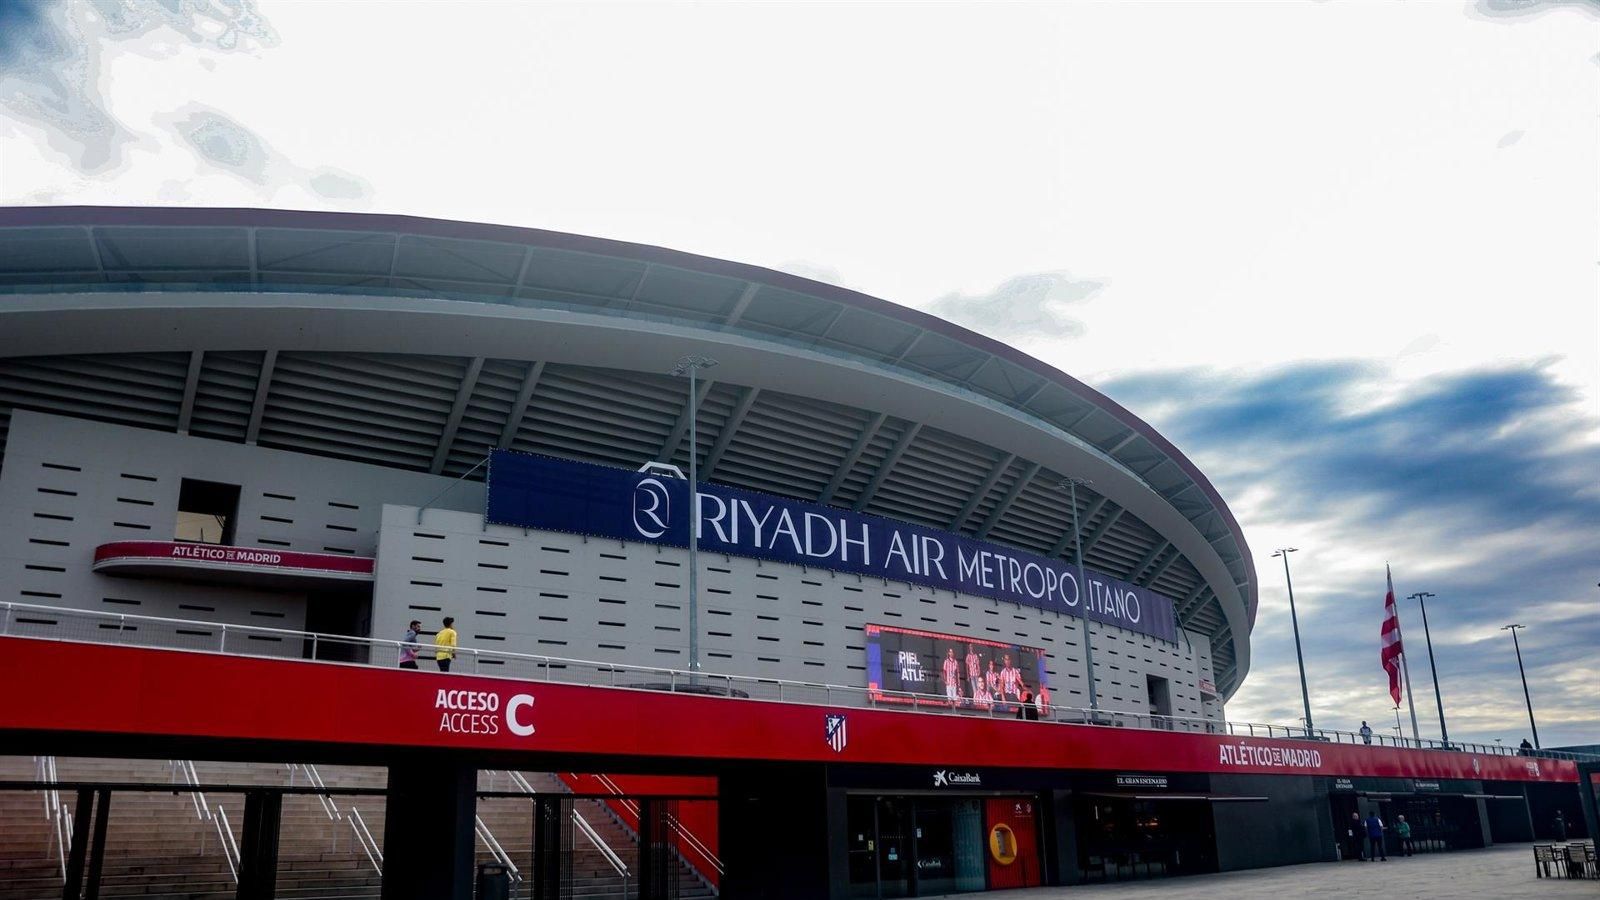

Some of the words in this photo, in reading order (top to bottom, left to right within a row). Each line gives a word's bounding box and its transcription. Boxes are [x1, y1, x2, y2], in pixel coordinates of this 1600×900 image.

[172, 546, 225, 559] ATLÉTICO
[236, 551, 281, 564] MADRID
[695, 491, 870, 566] RIYADH
[884, 530, 948, 580] AIR
[958, 544, 1141, 624] METROPOITANO
[898, 651, 920, 665] PIEL
[435, 689, 499, 712] ACCESO
[439, 712, 499, 735] ACCESS
[506, 694, 536, 737] C
[1219, 741, 1272, 765] ATLÉTICO
[1273, 750, 1282, 764] DE
[1281, 748, 1321, 768] MADRID
[948, 771, 981, 783] CaixaBank
